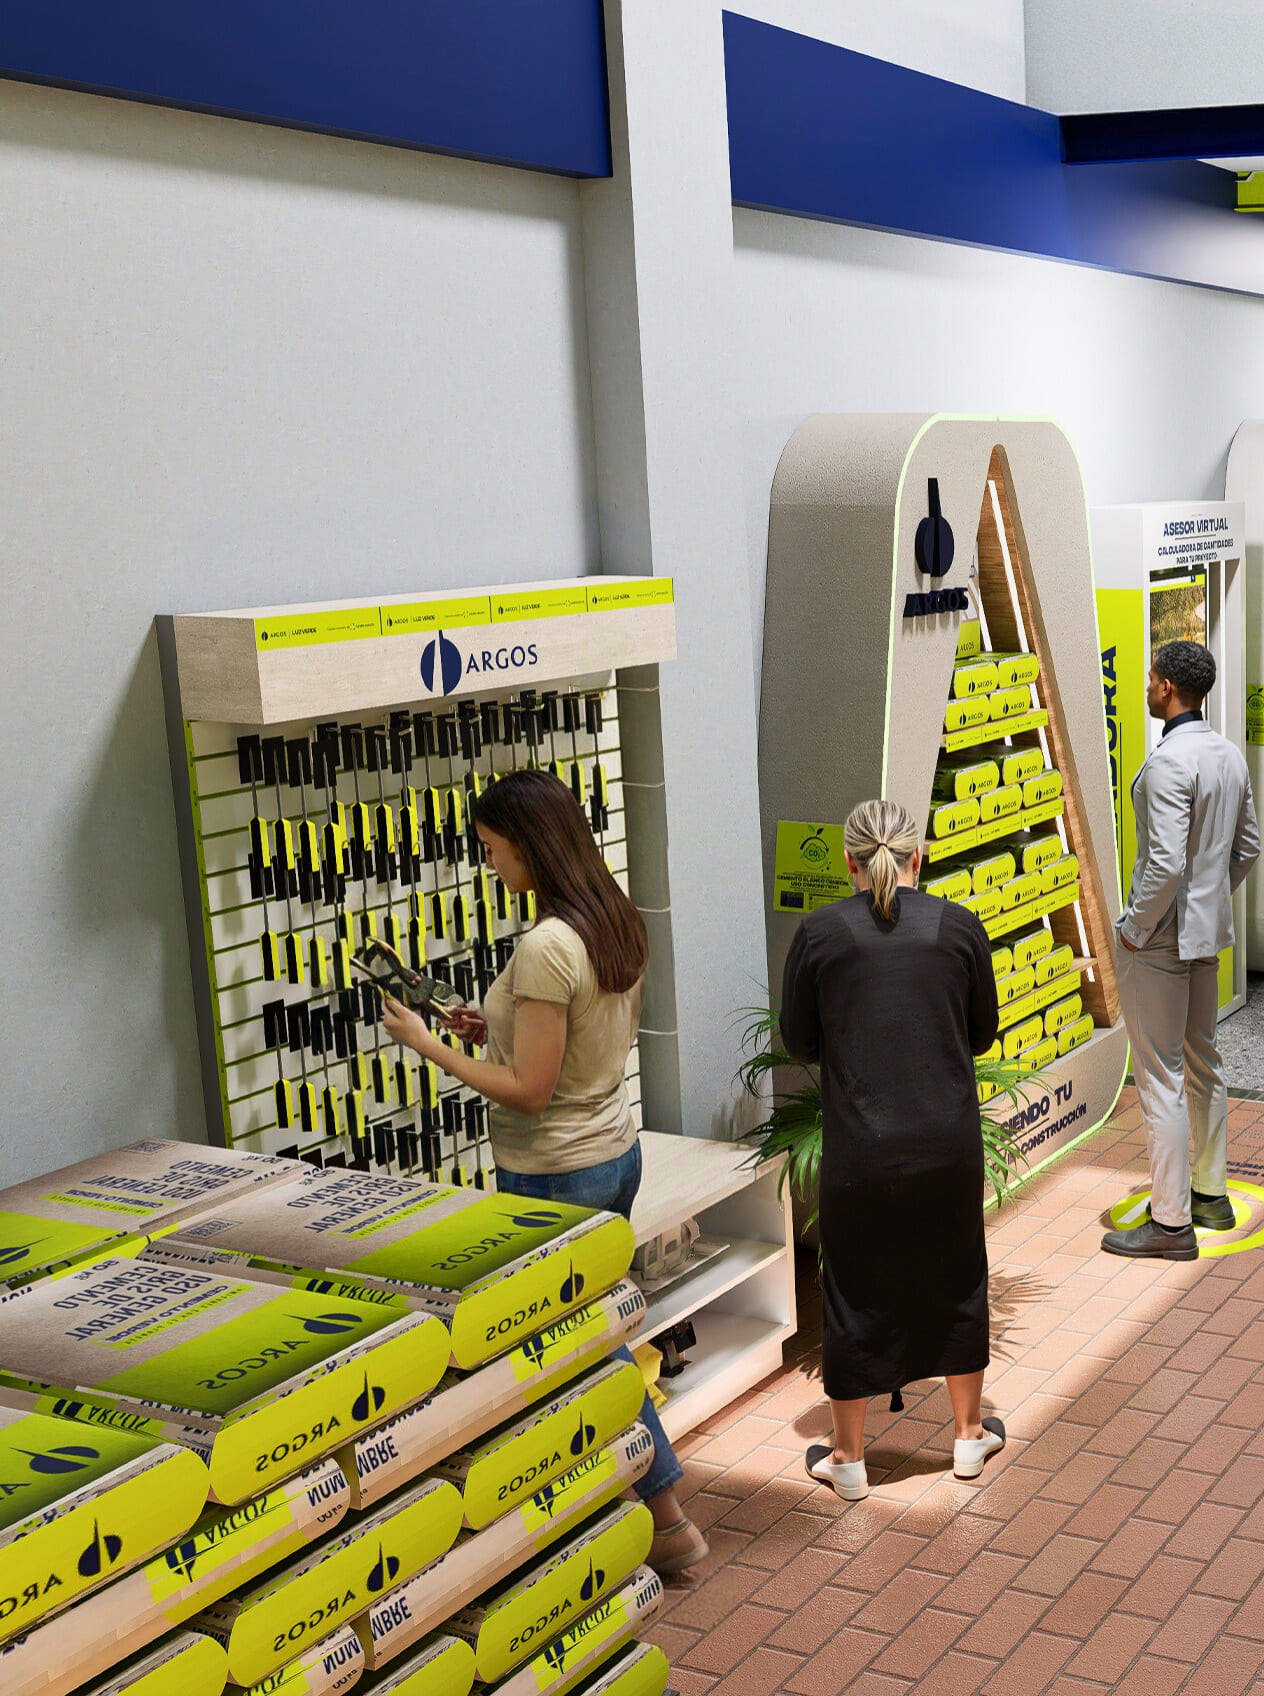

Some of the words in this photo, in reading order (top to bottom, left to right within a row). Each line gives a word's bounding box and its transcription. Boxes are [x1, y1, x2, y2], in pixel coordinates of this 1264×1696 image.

[1163, 520, 1195, 537] ASESOR
[1197, 517, 1228, 533] VIRTUAL
[1158, 542, 1196, 556] CALCULADORA
[1197, 541, 1203, 551] DE
[1204, 538, 1234, 550] CANTIDADES
[466, 644, 538, 674] ARGOS
[1054, 1080, 1073, 1106] TU
[1020, 1102, 1087, 1156] CONSTRUCCIÓN
